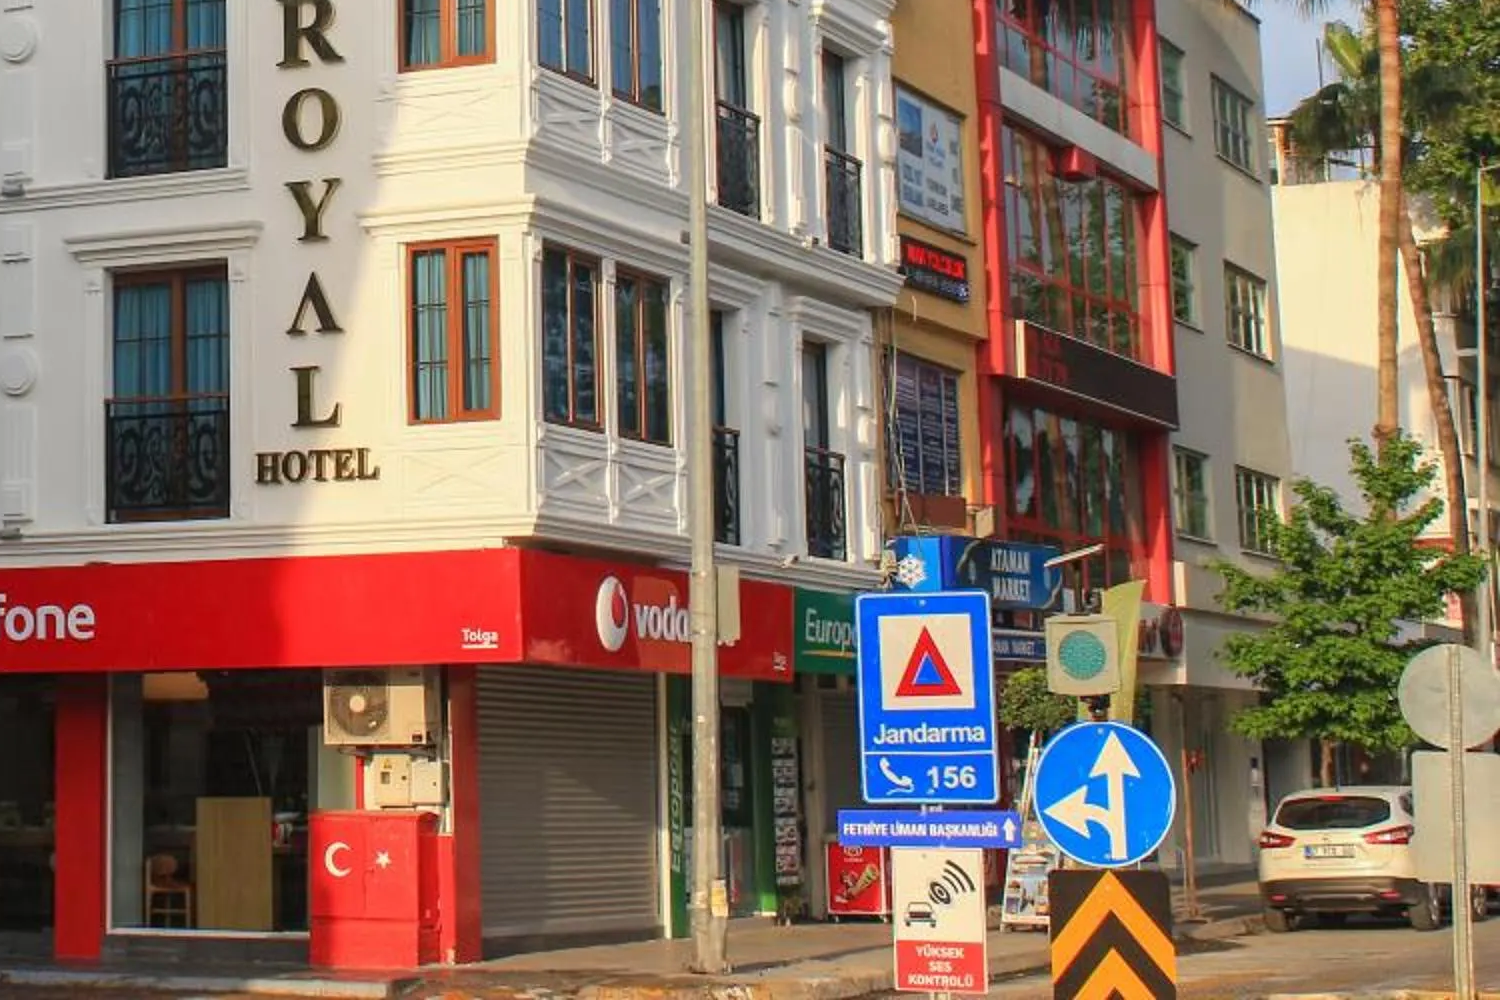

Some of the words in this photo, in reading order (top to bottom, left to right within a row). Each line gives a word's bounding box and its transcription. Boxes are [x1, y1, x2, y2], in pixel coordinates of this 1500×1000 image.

[255, 447, 380, 485] HOTEL
[990, 548, 1030, 574] ATAMAN
[993, 577, 1030, 602] MARKET
[460, 628, 498, 645] Tolga
[805, 607, 858, 656] Europ
[873, 722, 986, 745] Jandarma
[926, 765, 977, 789] 156
[844, 821, 888, 836] FETHİYE
[890, 821, 927, 836] LİMAN
[929, 821, 999, 839] BAŞKANLIĞI
[916, 943, 965, 959] YÜKSEK
[928, 961, 953, 973] SES
[908, 973, 974, 988] KONTROLÜ
